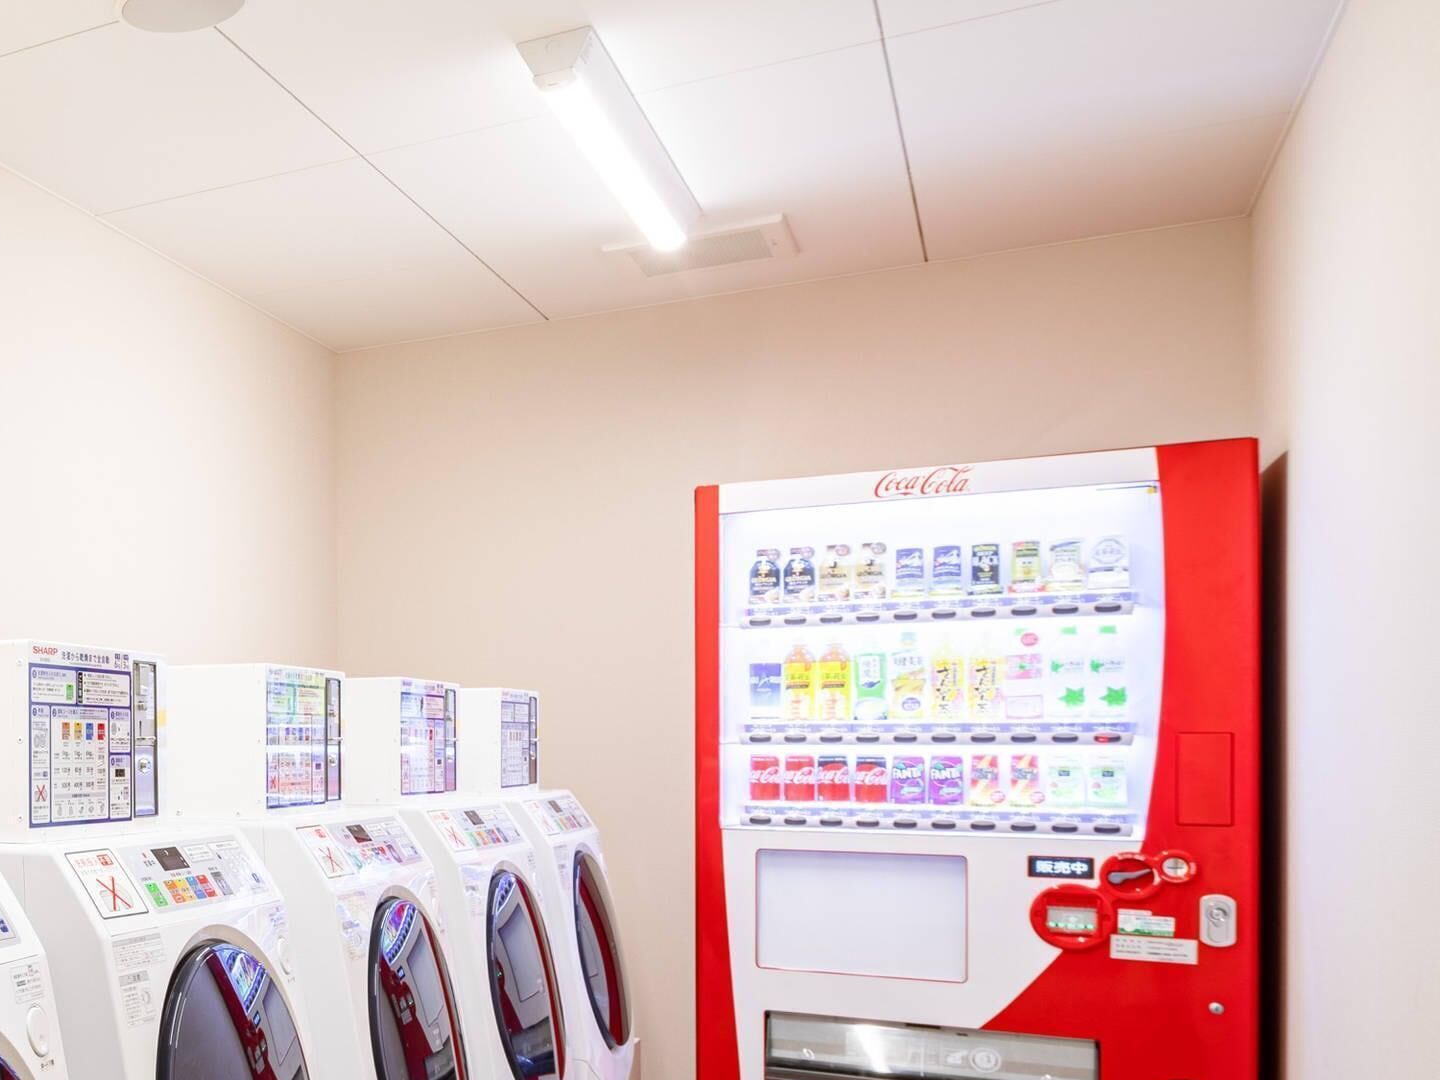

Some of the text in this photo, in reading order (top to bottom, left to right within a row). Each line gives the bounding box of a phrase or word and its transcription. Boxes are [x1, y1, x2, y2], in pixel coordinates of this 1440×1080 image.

[874, 465, 976, 499] Coca-Cola
[32, 645, 59, 656] SHARP
[1035, 859, 1089, 875] 販売中
